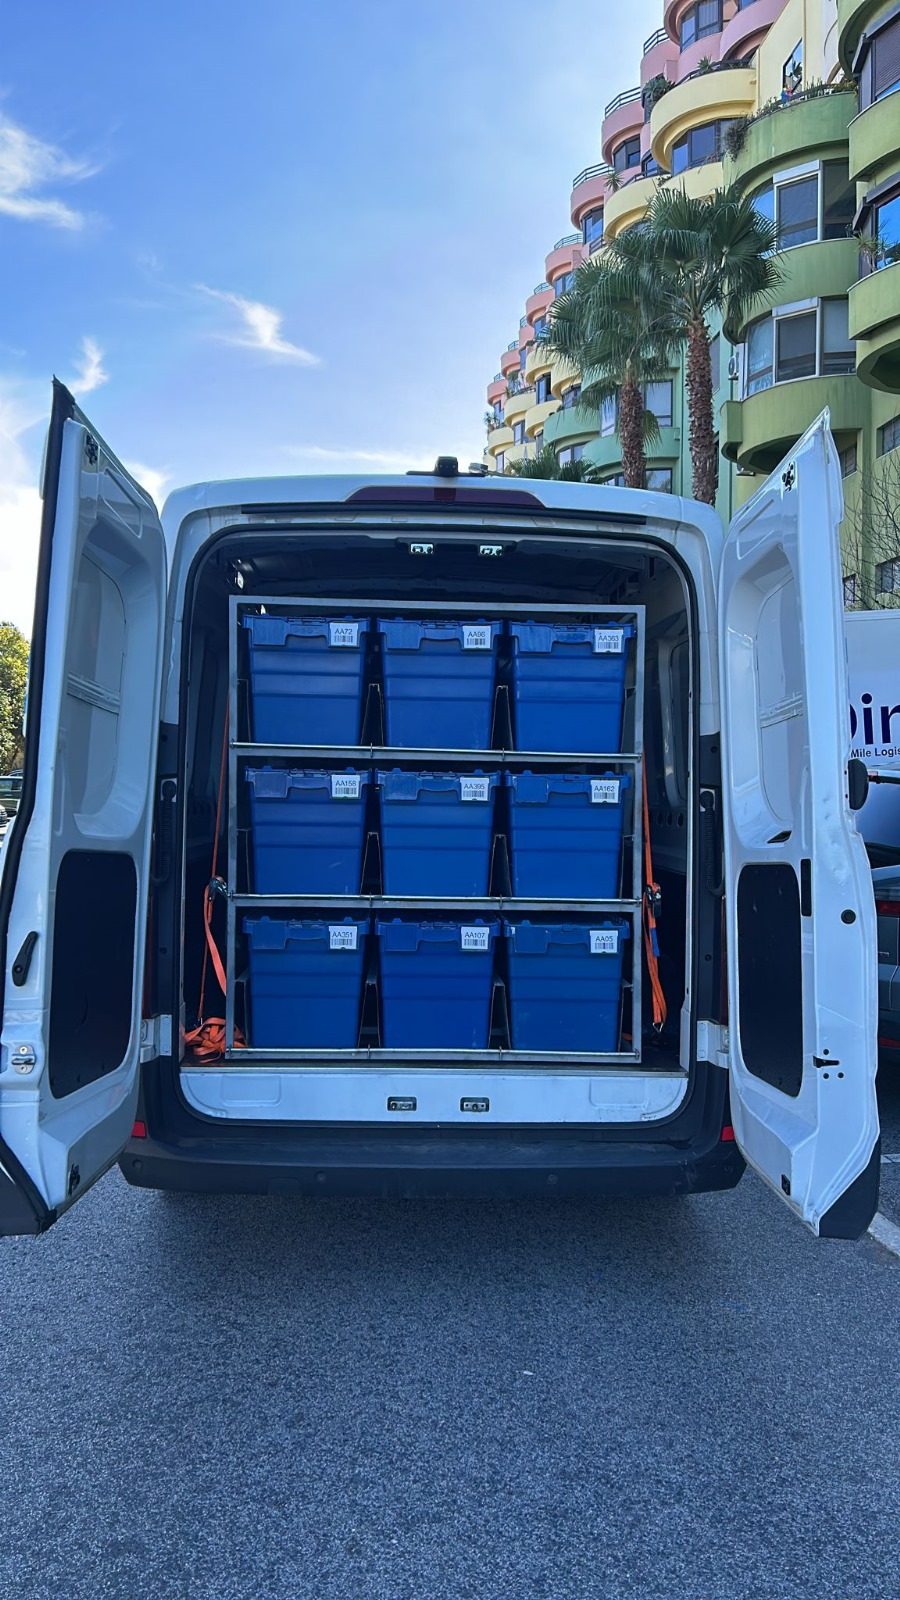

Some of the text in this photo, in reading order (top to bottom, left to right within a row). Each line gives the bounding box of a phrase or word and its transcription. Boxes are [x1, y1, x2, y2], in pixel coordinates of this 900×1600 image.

[334, 628, 353, 636] AA72
[851, 748, 871, 758] Mile
[335, 780, 357, 788] AA158
[594, 784, 616, 792] AA162
[331, 931, 354, 939] AA351
[464, 932, 486, 940] AA107
